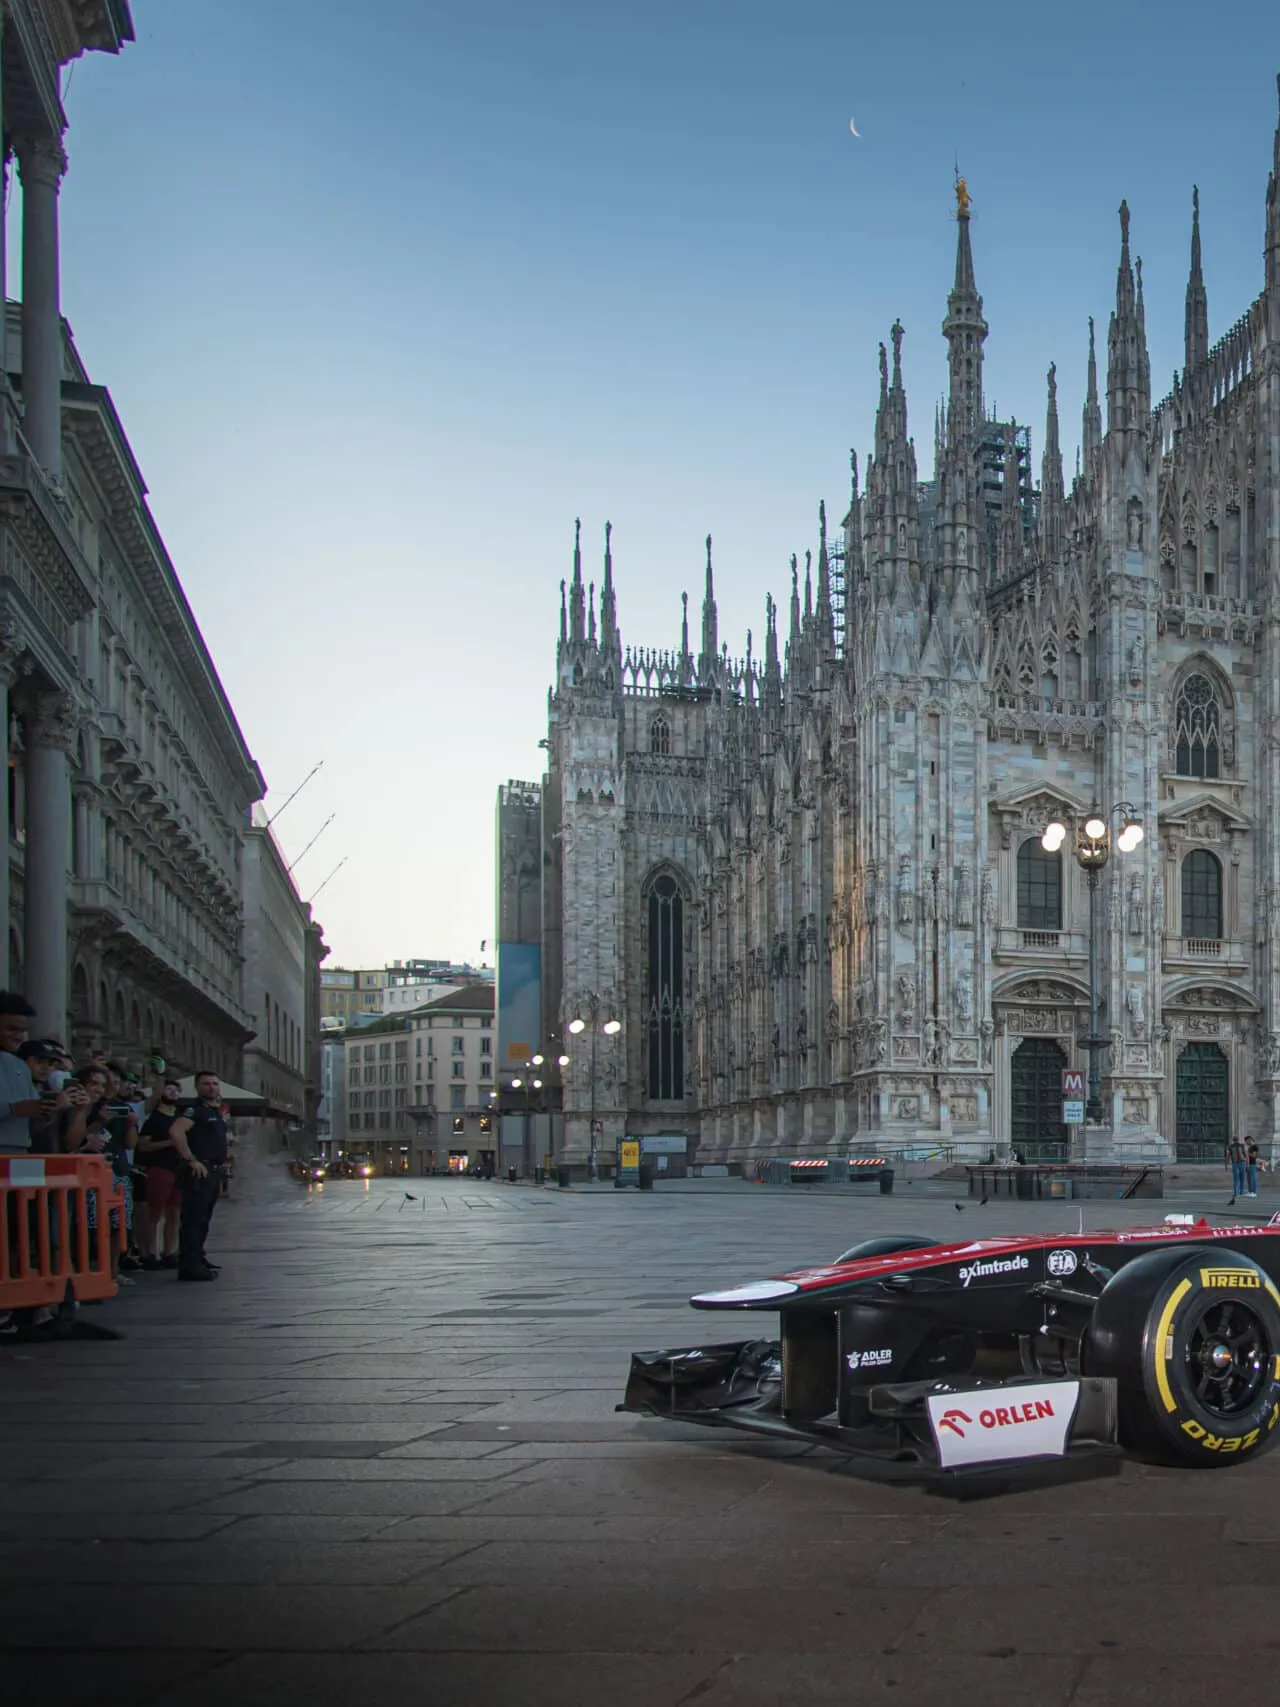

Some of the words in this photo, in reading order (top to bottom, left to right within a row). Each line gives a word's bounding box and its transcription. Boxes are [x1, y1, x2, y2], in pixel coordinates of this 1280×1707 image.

[1065, 1075, 1082, 1089] M
[958, 1255, 1030, 1287] aximtrade
[1048, 1252, 1076, 1273] FIA
[1199, 1267, 1261, 1289] PIRELLI
[861, 1349, 893, 1361] ADLER
[978, 1399, 1056, 1430] ORLEN
[1180, 1418, 1261, 1453] ZERO
